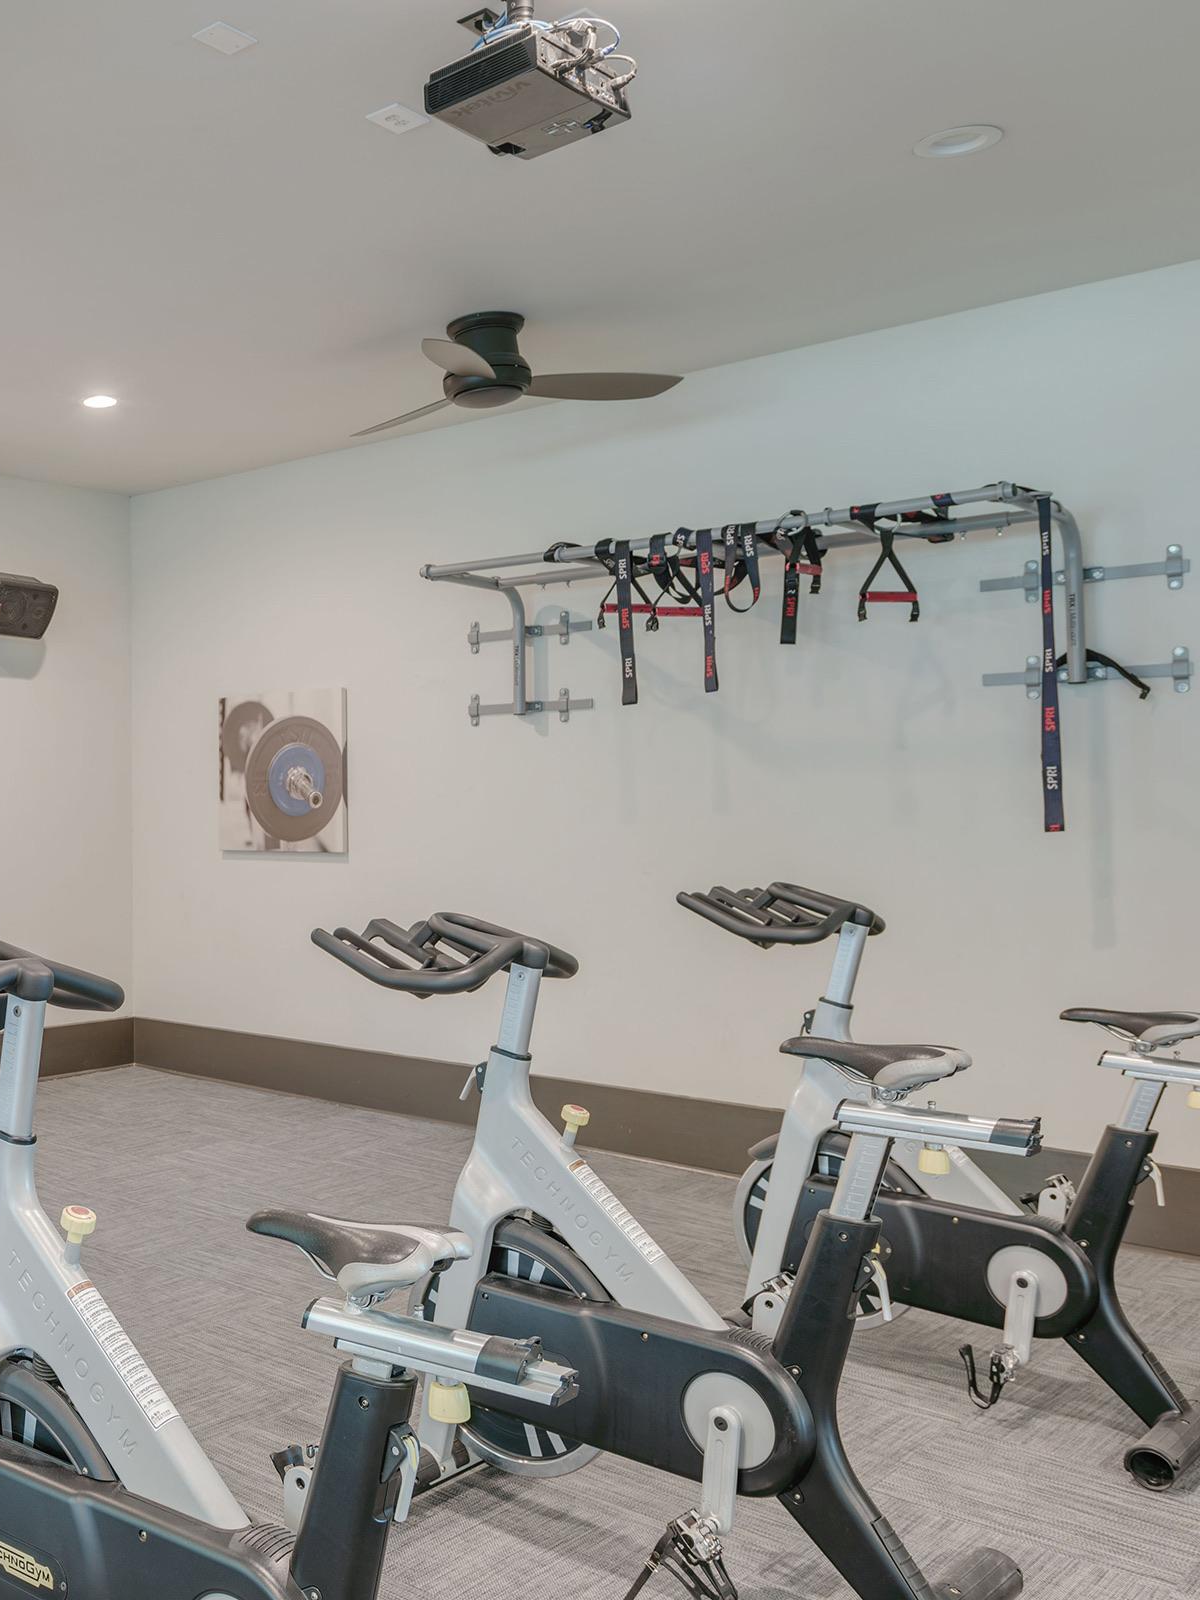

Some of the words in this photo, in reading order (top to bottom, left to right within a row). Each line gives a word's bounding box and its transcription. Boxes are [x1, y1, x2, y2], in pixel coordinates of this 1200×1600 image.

[744, 534, 755, 558] SPRI
[1042, 531, 1050, 556] SPRI
[618, 558, 628, 580] SPRI
[701, 551, 710, 576] SPRI
[621, 607, 631, 630] SPRI
[703, 603, 712, 627] SPRI
[624, 657, 633, 679] SPRI
[1045, 648, 1054, 673] SPRI
[1044, 706, 1057, 733] SPRI
[1046, 765, 1058, 790] SPRI
[511, 1136, 634, 1284] TECHNOGYM
[7, 1250, 137, 1455] TECHNOGYM
